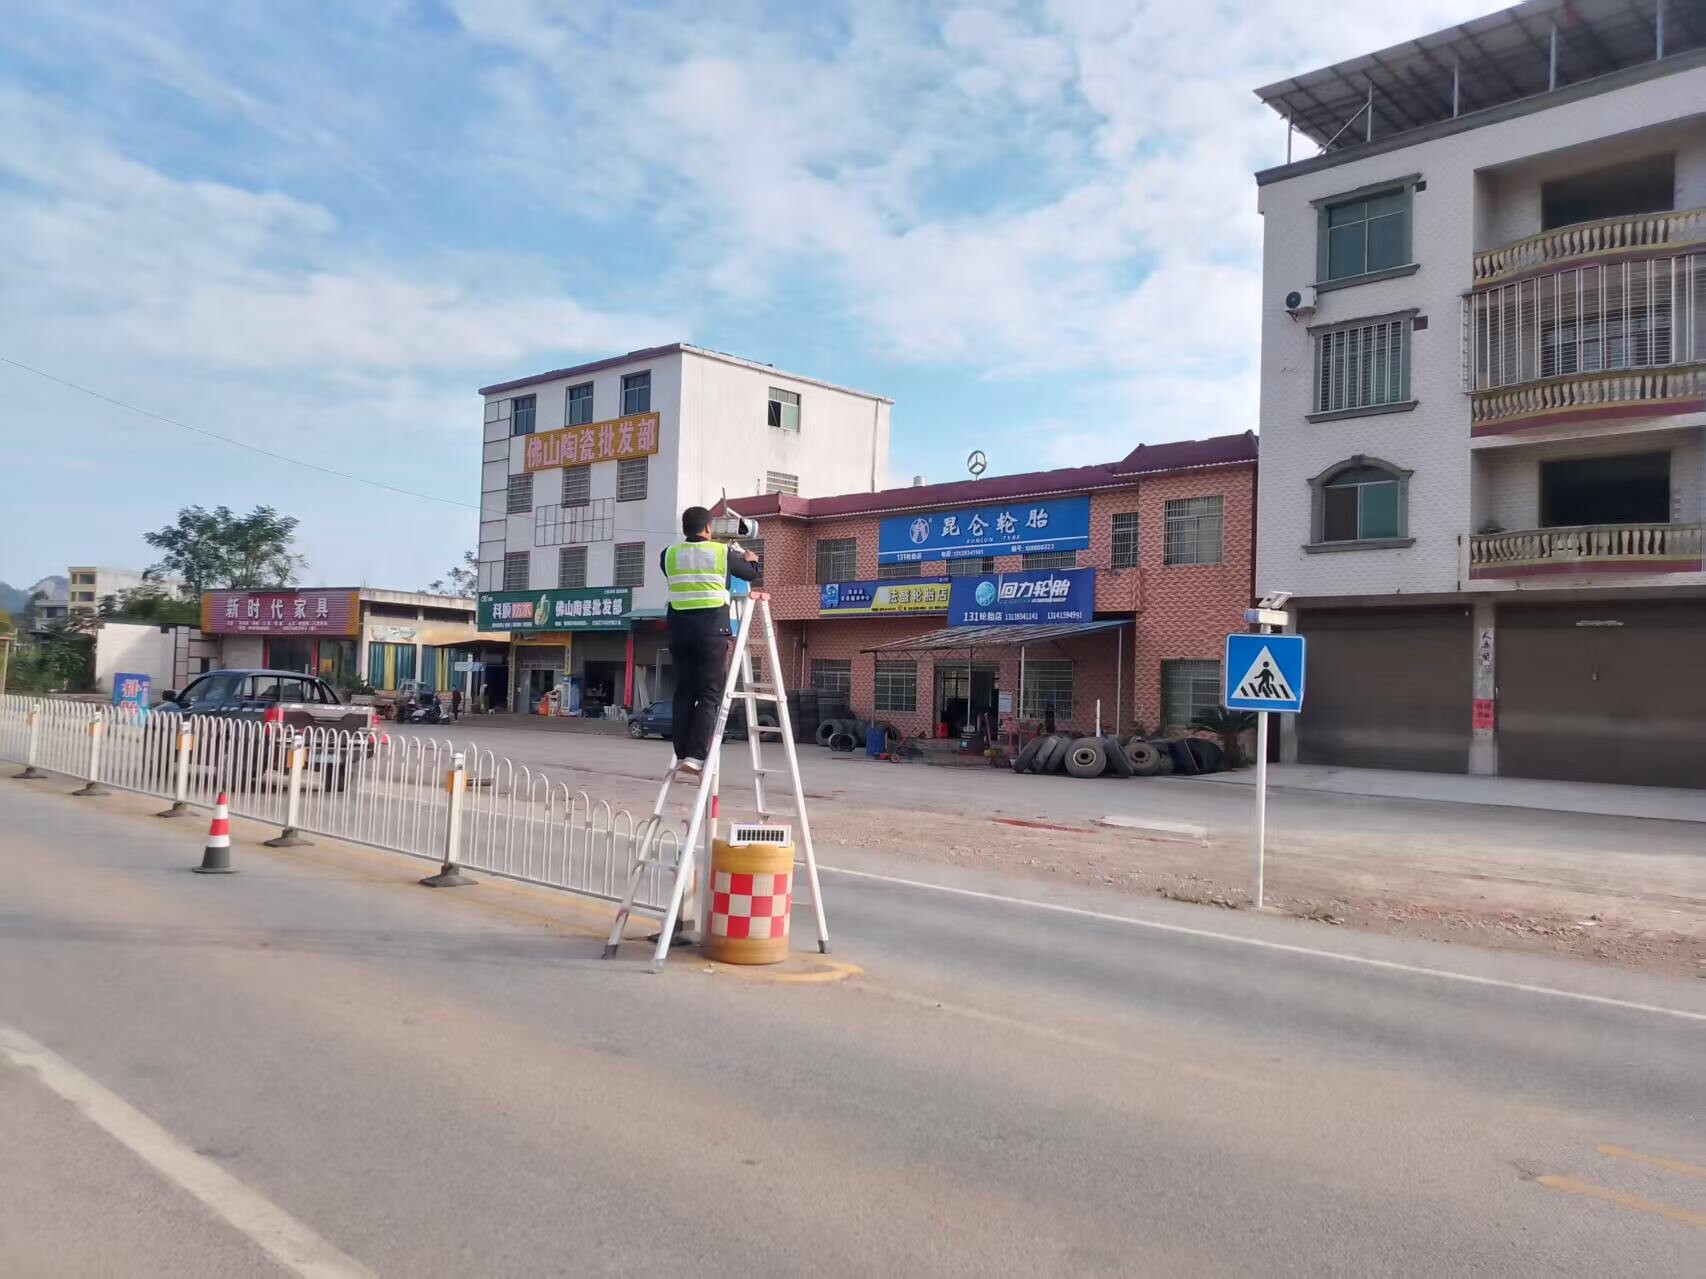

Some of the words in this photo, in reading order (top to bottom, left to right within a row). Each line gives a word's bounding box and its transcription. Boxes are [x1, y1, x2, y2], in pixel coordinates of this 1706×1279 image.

[527, 418, 656, 469] 佛山陶瓷批发部
[941, 508, 1049, 537] 昆仑轮胎
[1000, 579, 1071, 599] 回力轮胎
[225, 598, 329, 619] 新时代家具
[555, 598, 623, 617] 佛山陶瓷批发部
[963, 611, 1003, 621] 131轮胎店
